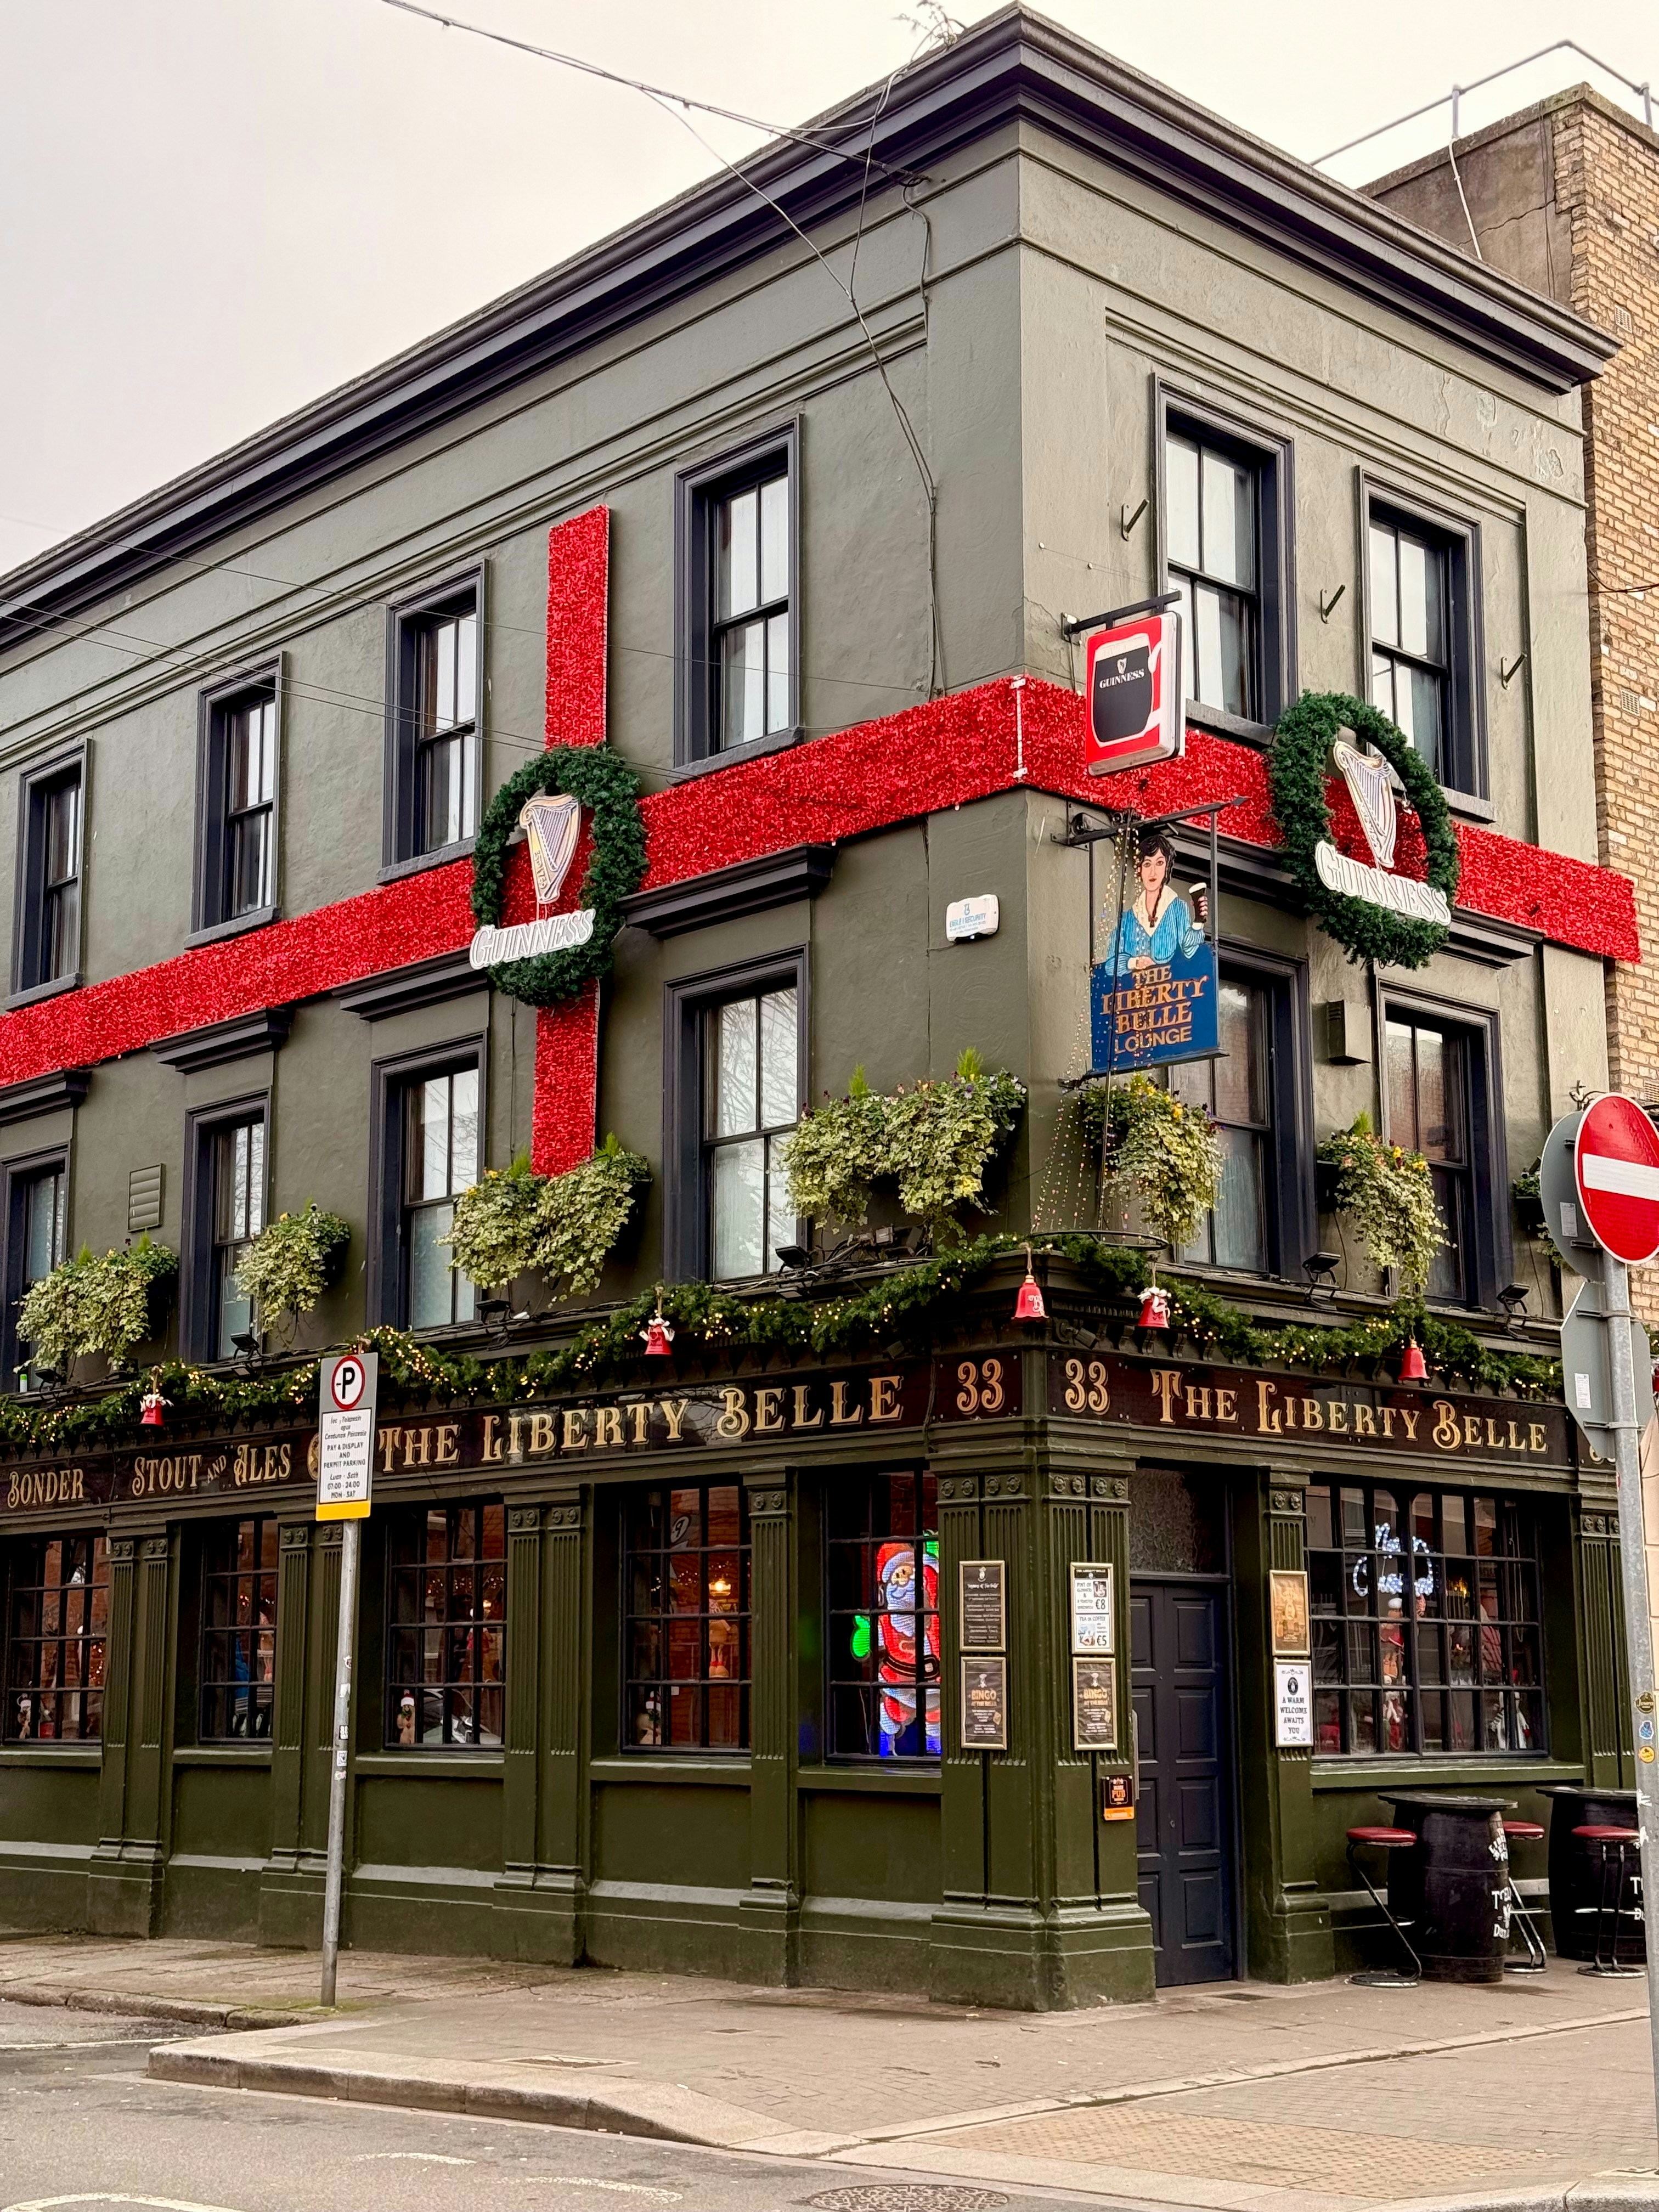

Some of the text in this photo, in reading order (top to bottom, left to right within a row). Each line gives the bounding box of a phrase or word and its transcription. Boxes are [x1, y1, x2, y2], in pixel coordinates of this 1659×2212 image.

[1099, 669, 1144, 689] GUINNESS
[1316, 841, 1451, 924] GUINNESS
[965, 913, 986, 923] SECURITY
[470, 909, 595, 969] GUINNESS
[1132, 965, 1172, 989] THE
[1100, 975, 1209, 1014] LIBERTY
[1115, 1026, 1192, 1054] LOUNGE
[342, 1367, 356, 1399] P
[956, 1359, 1006, 1415] 33
[1065, 1358, 1548, 1454] 33 THE LIBERTY BELLE
[378, 1375, 904, 1472] THE LIBERTY BELLE
[342, 1442, 364, 1450] DISPLAY
[132, 1444, 292, 1497] STOUT AND ALES
[7, 1469, 84, 1508] BONDER
[1096, 1599, 1105, 1610] €8
[1097, 1635, 1107, 1646] €5
[971, 1690, 997, 1700] BINGO
[1084, 1689, 1108, 1700] BINGO
